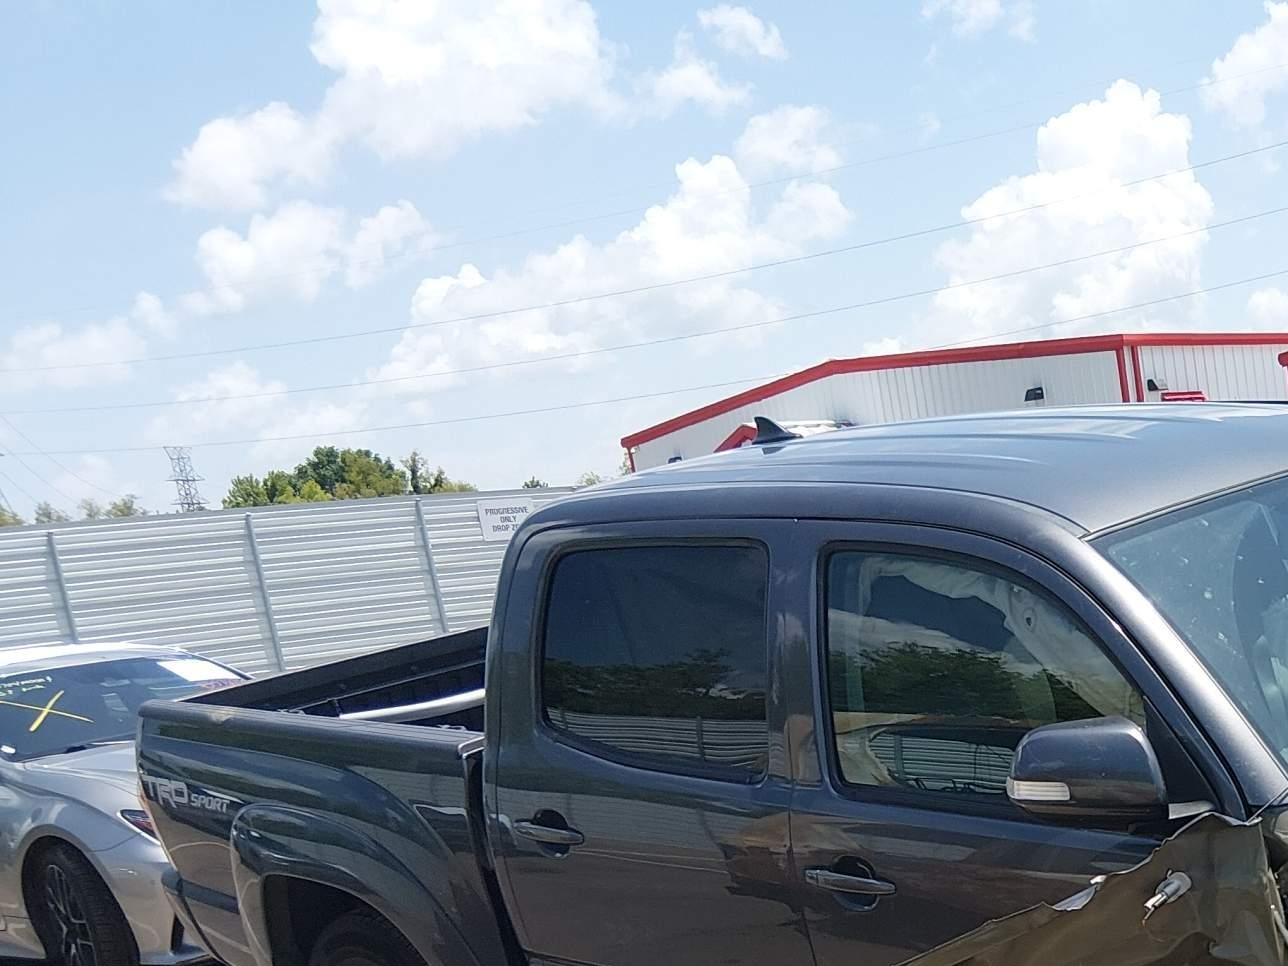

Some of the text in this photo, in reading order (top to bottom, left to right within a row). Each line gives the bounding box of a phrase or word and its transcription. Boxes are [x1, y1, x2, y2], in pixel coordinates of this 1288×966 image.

[485, 507, 529, 515] PROGRESSIVE
[492, 524, 509, 532] DROP
[190, 793, 230, 813] SPORT
